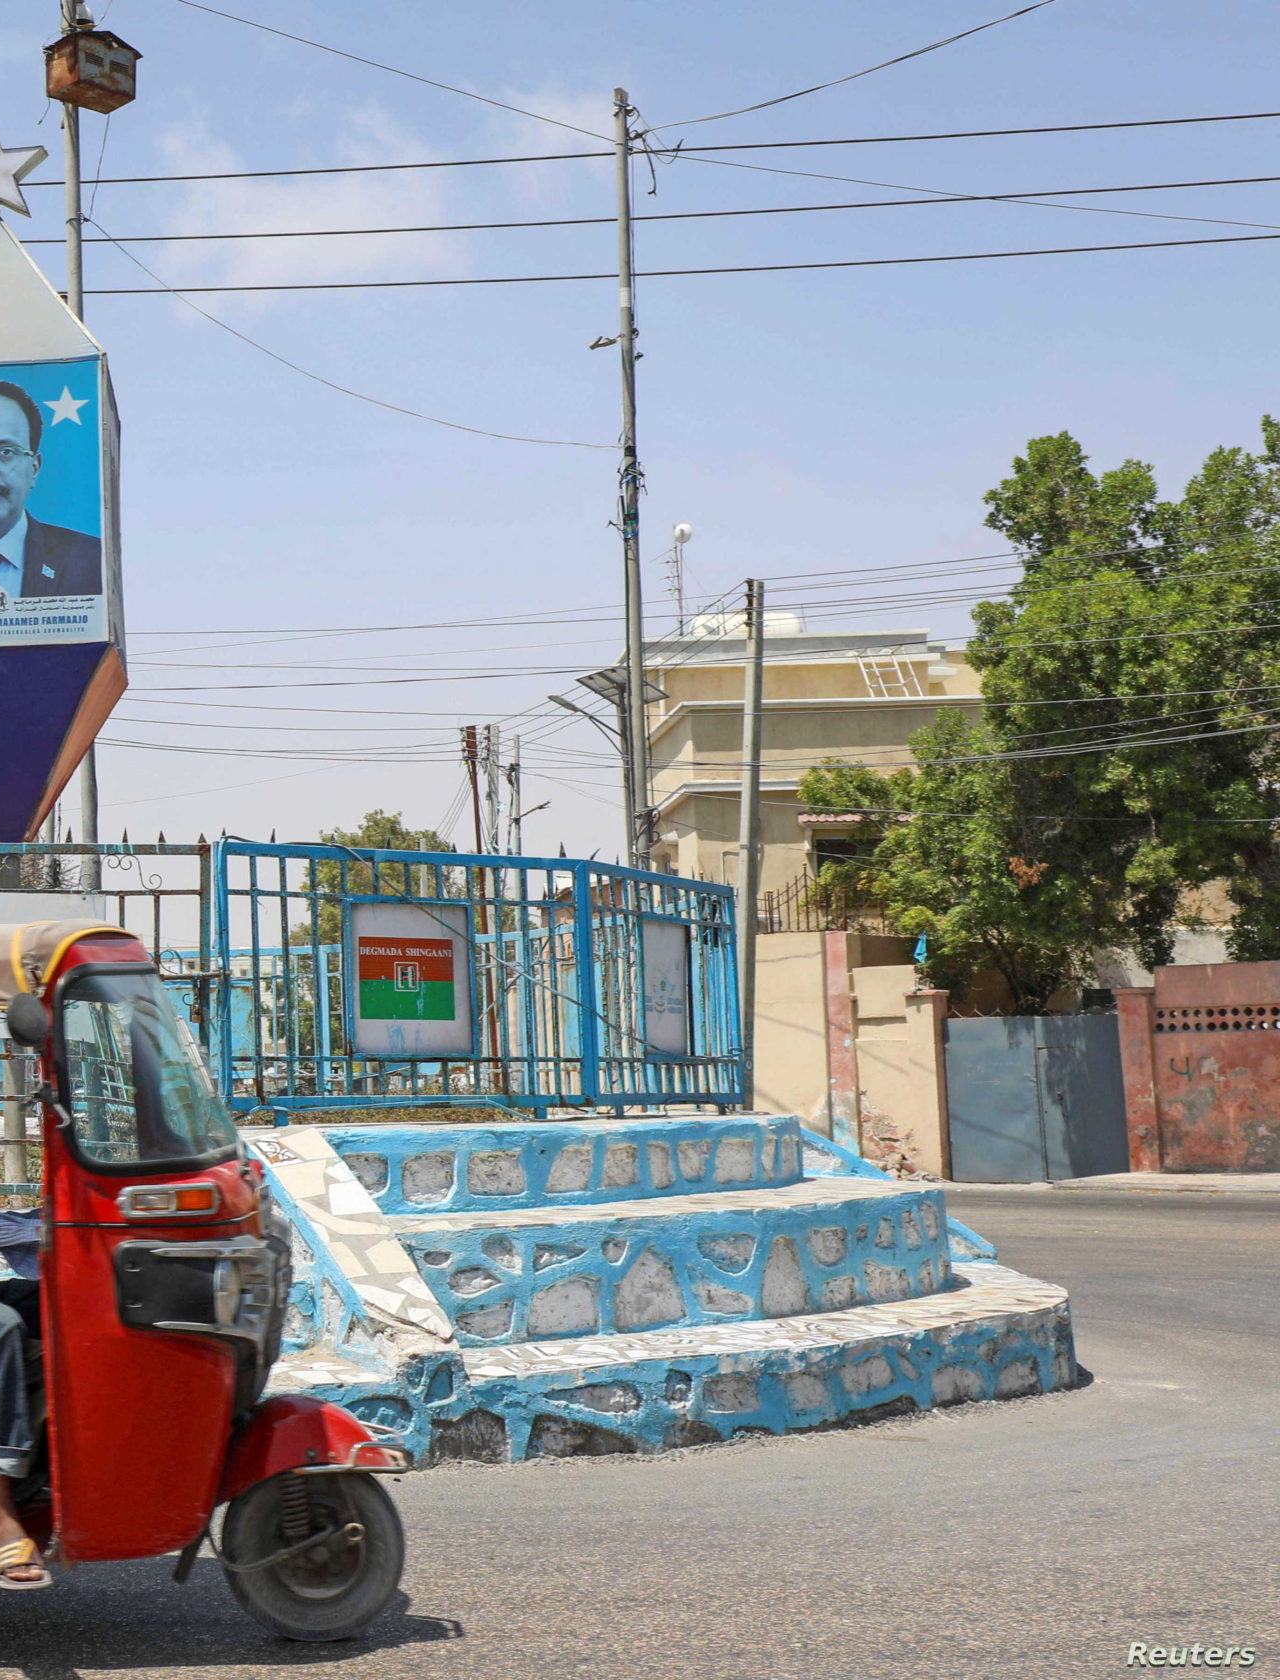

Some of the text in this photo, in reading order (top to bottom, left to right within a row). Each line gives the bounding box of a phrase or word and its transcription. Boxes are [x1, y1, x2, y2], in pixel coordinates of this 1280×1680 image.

[41, 615, 88, 625] FARMAAJO
[359, 946, 453, 958] DEGMADA SHINGAANI
